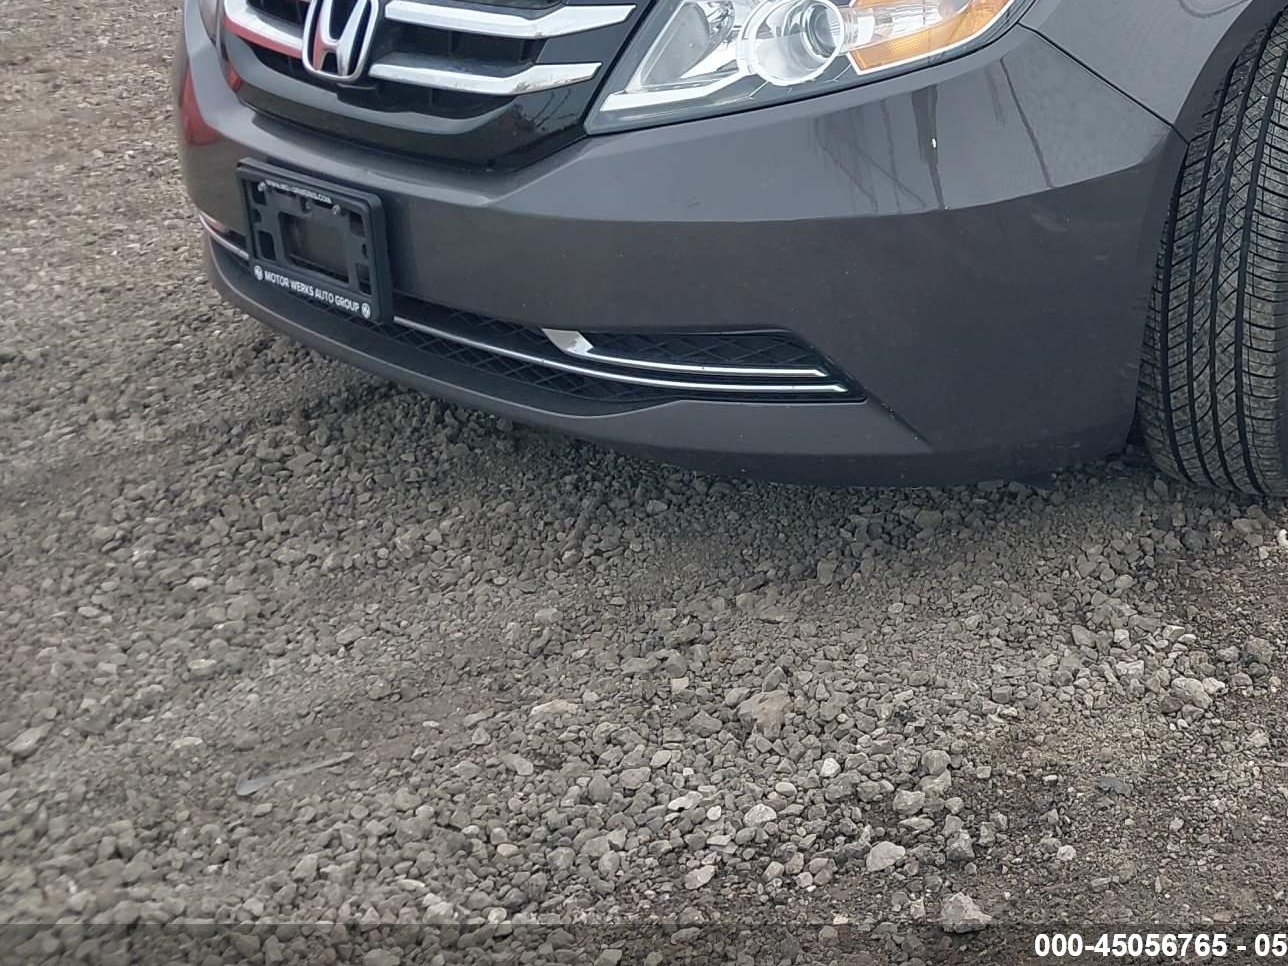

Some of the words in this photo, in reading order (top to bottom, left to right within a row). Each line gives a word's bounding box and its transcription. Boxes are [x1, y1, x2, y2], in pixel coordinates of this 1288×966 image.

[264, 270, 290, 288] MOTOR
[290, 279, 314, 297] WERKS
[315, 287, 334, 304] AUTO
[334, 294, 360, 313] GROUP
